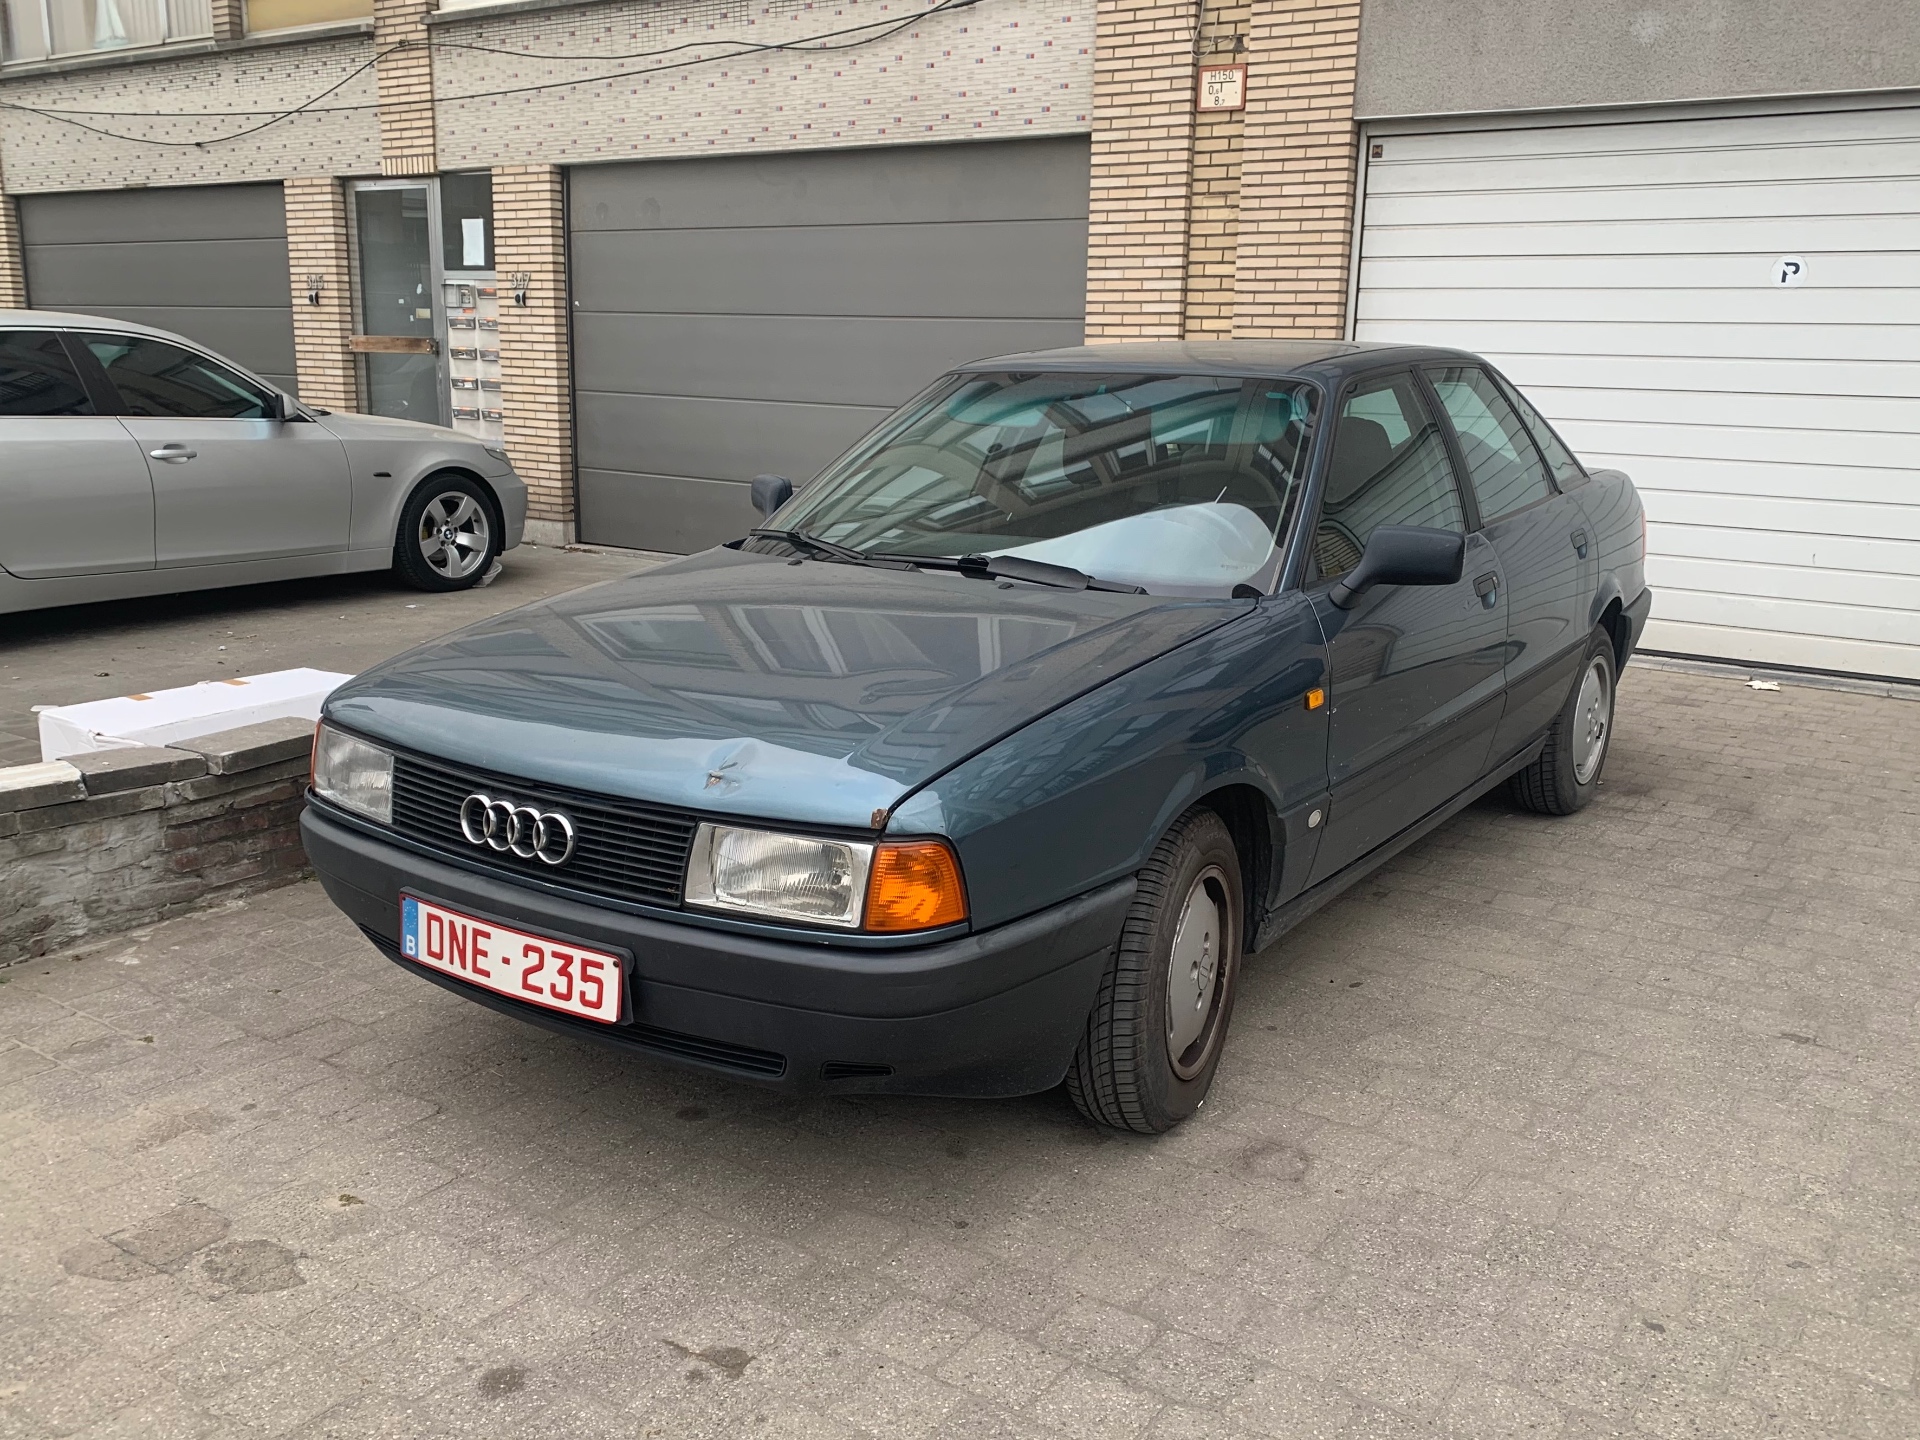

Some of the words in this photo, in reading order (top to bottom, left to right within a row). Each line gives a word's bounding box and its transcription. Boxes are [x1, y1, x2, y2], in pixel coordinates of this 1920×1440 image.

[1210, 70, 1234, 81] H150
[511, 272, 531, 288] 347
[406, 934, 416, 956] B
[426, 911, 604, 1010] DNE-235
